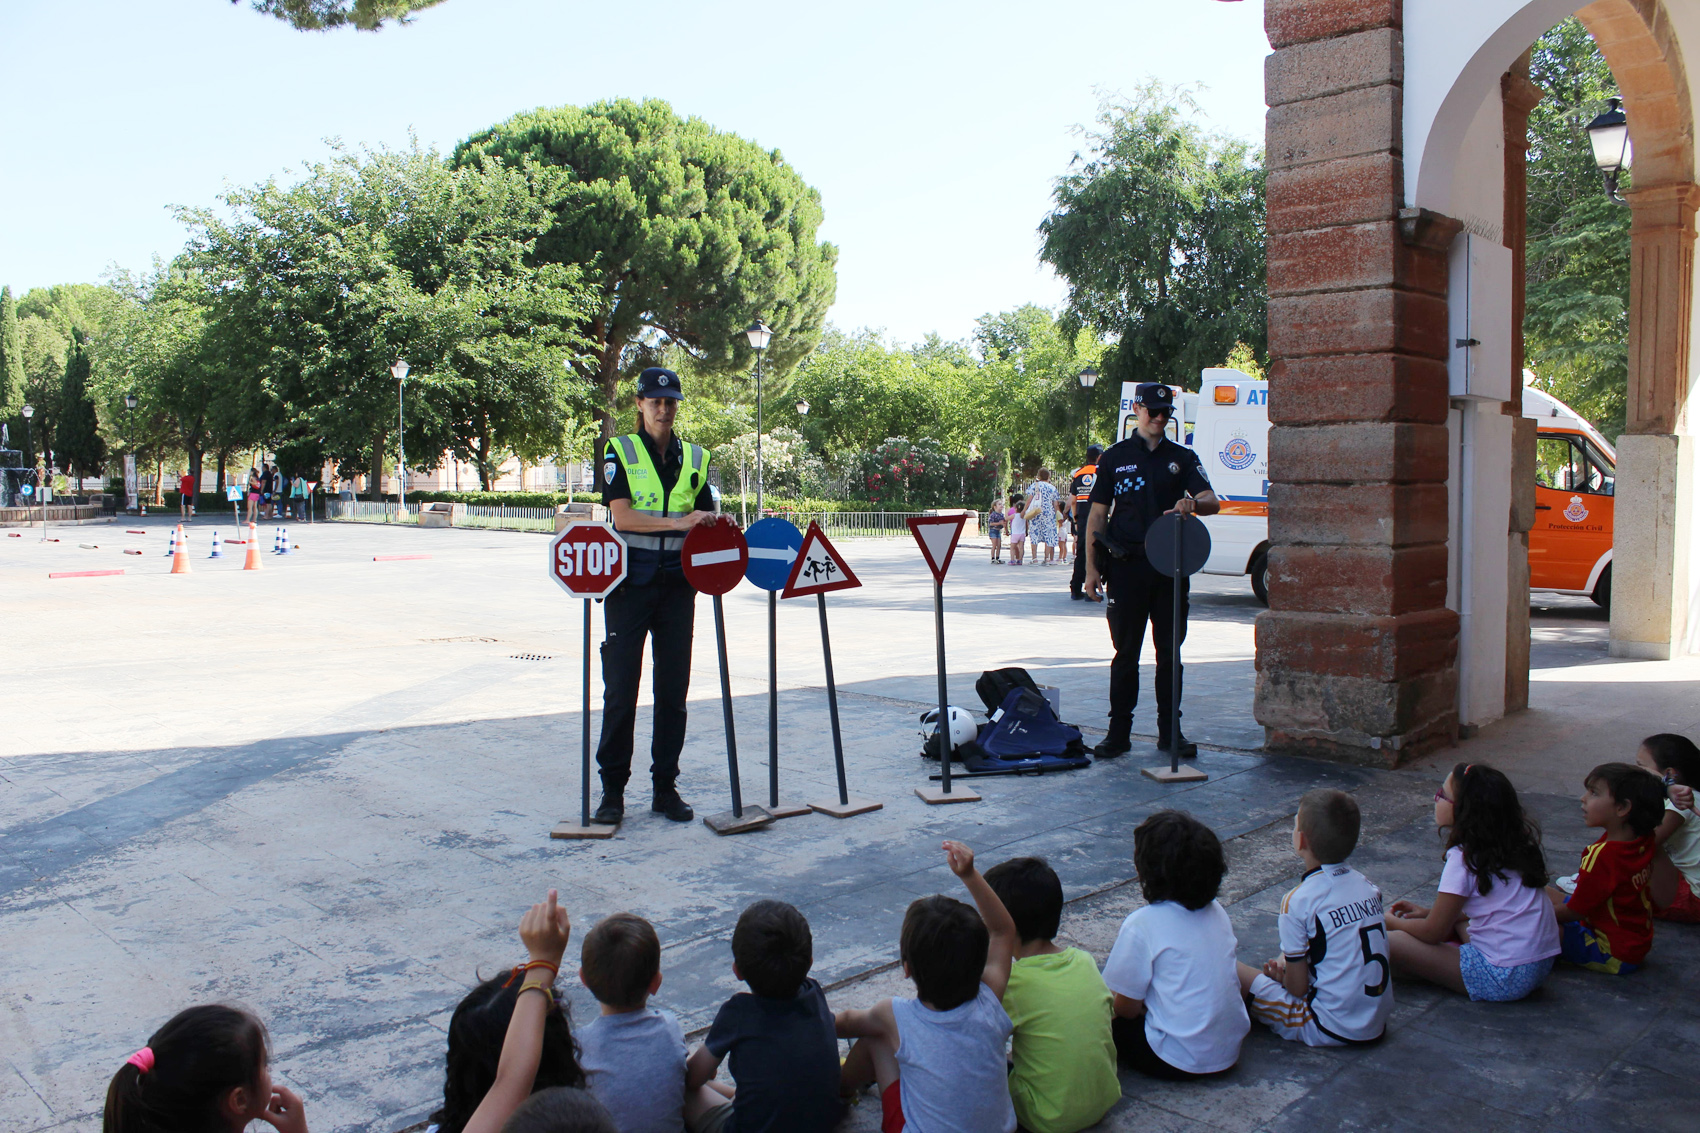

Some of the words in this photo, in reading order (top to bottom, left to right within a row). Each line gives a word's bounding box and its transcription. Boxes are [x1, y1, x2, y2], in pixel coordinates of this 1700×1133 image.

[1115, 464, 1138, 473] POLICIA
[558, 542, 619, 576] STOP
[1328, 896, 1384, 928] BELLINGHA
[1359, 922, 1390, 997] 5
